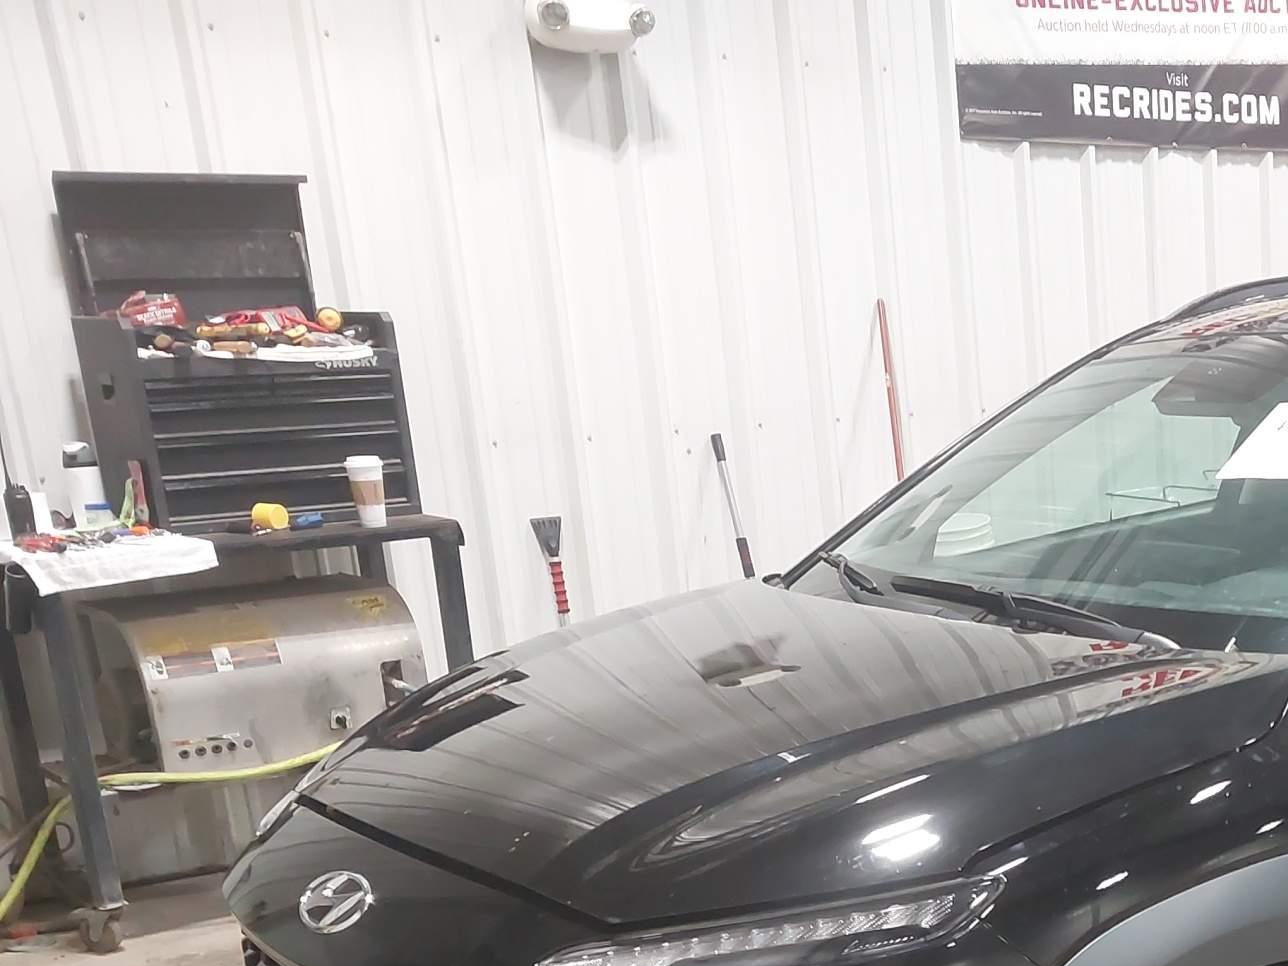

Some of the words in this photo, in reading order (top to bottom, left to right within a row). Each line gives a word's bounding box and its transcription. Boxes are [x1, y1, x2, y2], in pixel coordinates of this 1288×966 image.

[1037, 18, 1082, 33] Auction
[1085, 20, 1109, 33] held
[1112, 20, 1177, 36] Wednesdays
[1179, 22, 1191, 34] at
[1194, 24, 1221, 34] noon
[1223, 22, 1237, 34] ET
[1165, 72, 1189, 87] Visit
[1072, 83, 1281, 125] RECRIDES.COM
